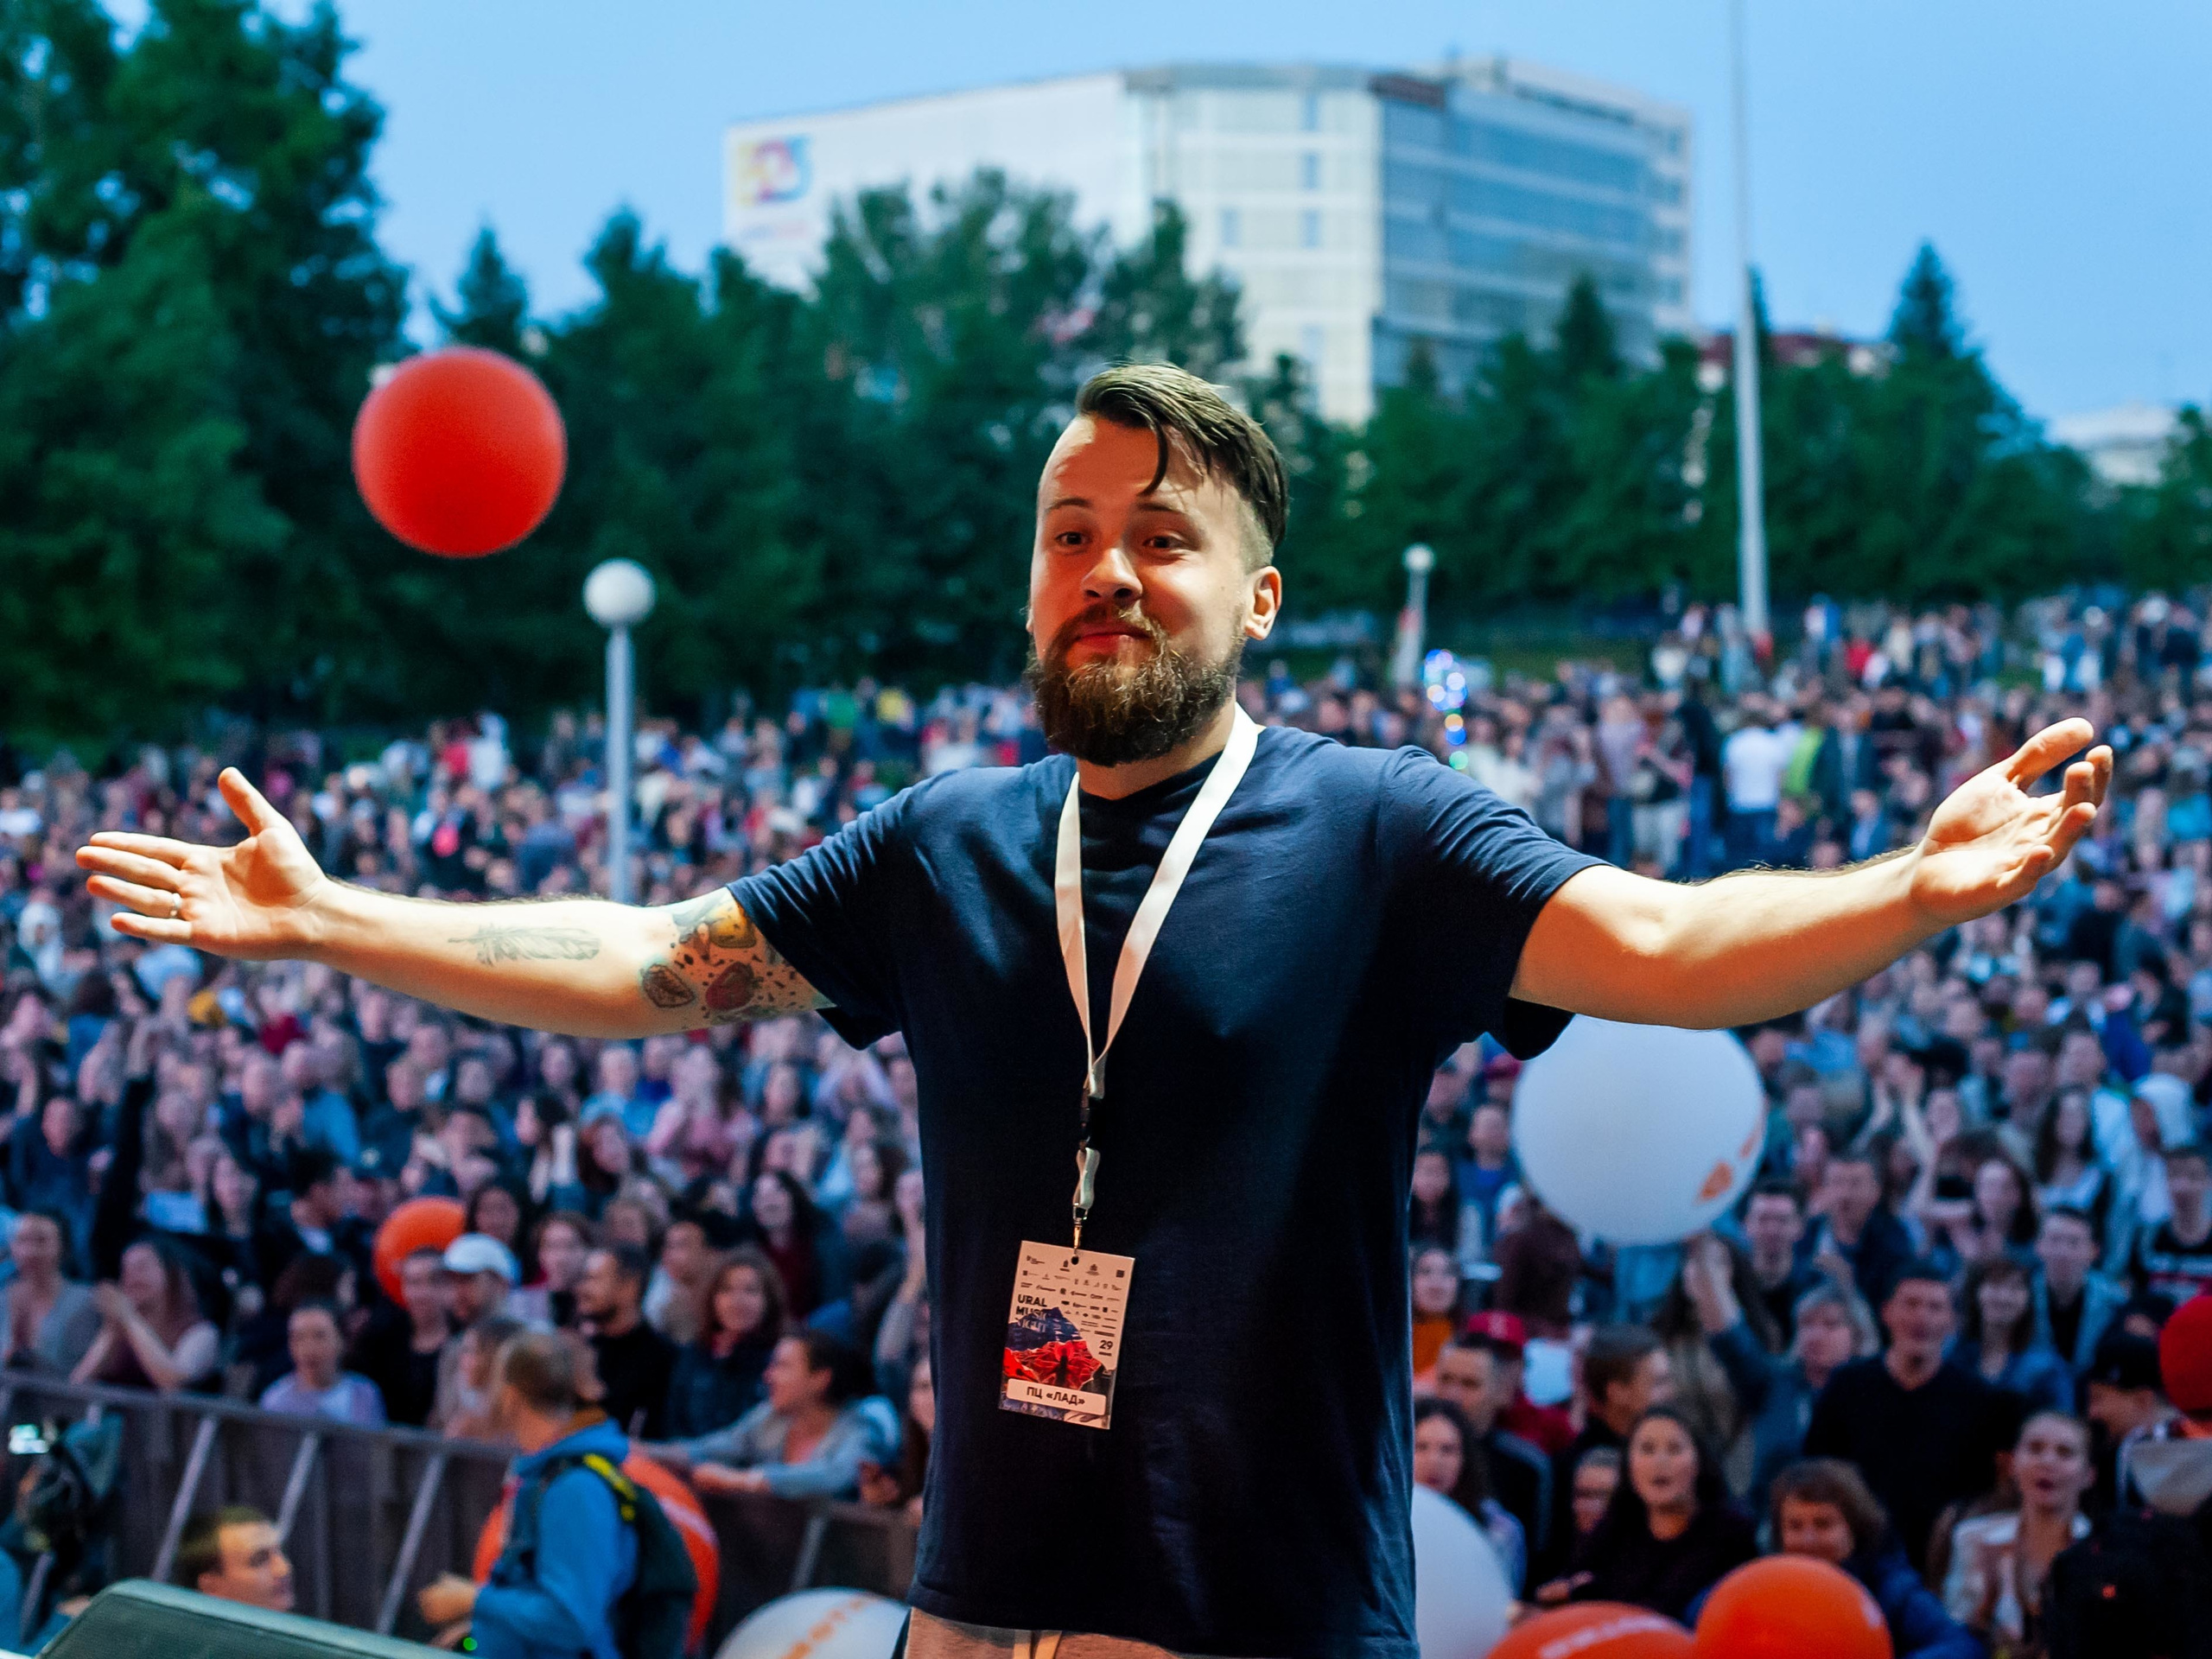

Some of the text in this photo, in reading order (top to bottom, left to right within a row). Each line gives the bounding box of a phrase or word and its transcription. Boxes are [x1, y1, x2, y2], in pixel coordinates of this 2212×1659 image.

[1018, 1294, 1047, 1307] URAL
[1015, 1306, 1047, 1321] MUSIC
[1099, 1339, 1113, 1350] 29
[1027, 1386, 1085, 1406] ПЦ «ЛАД»
